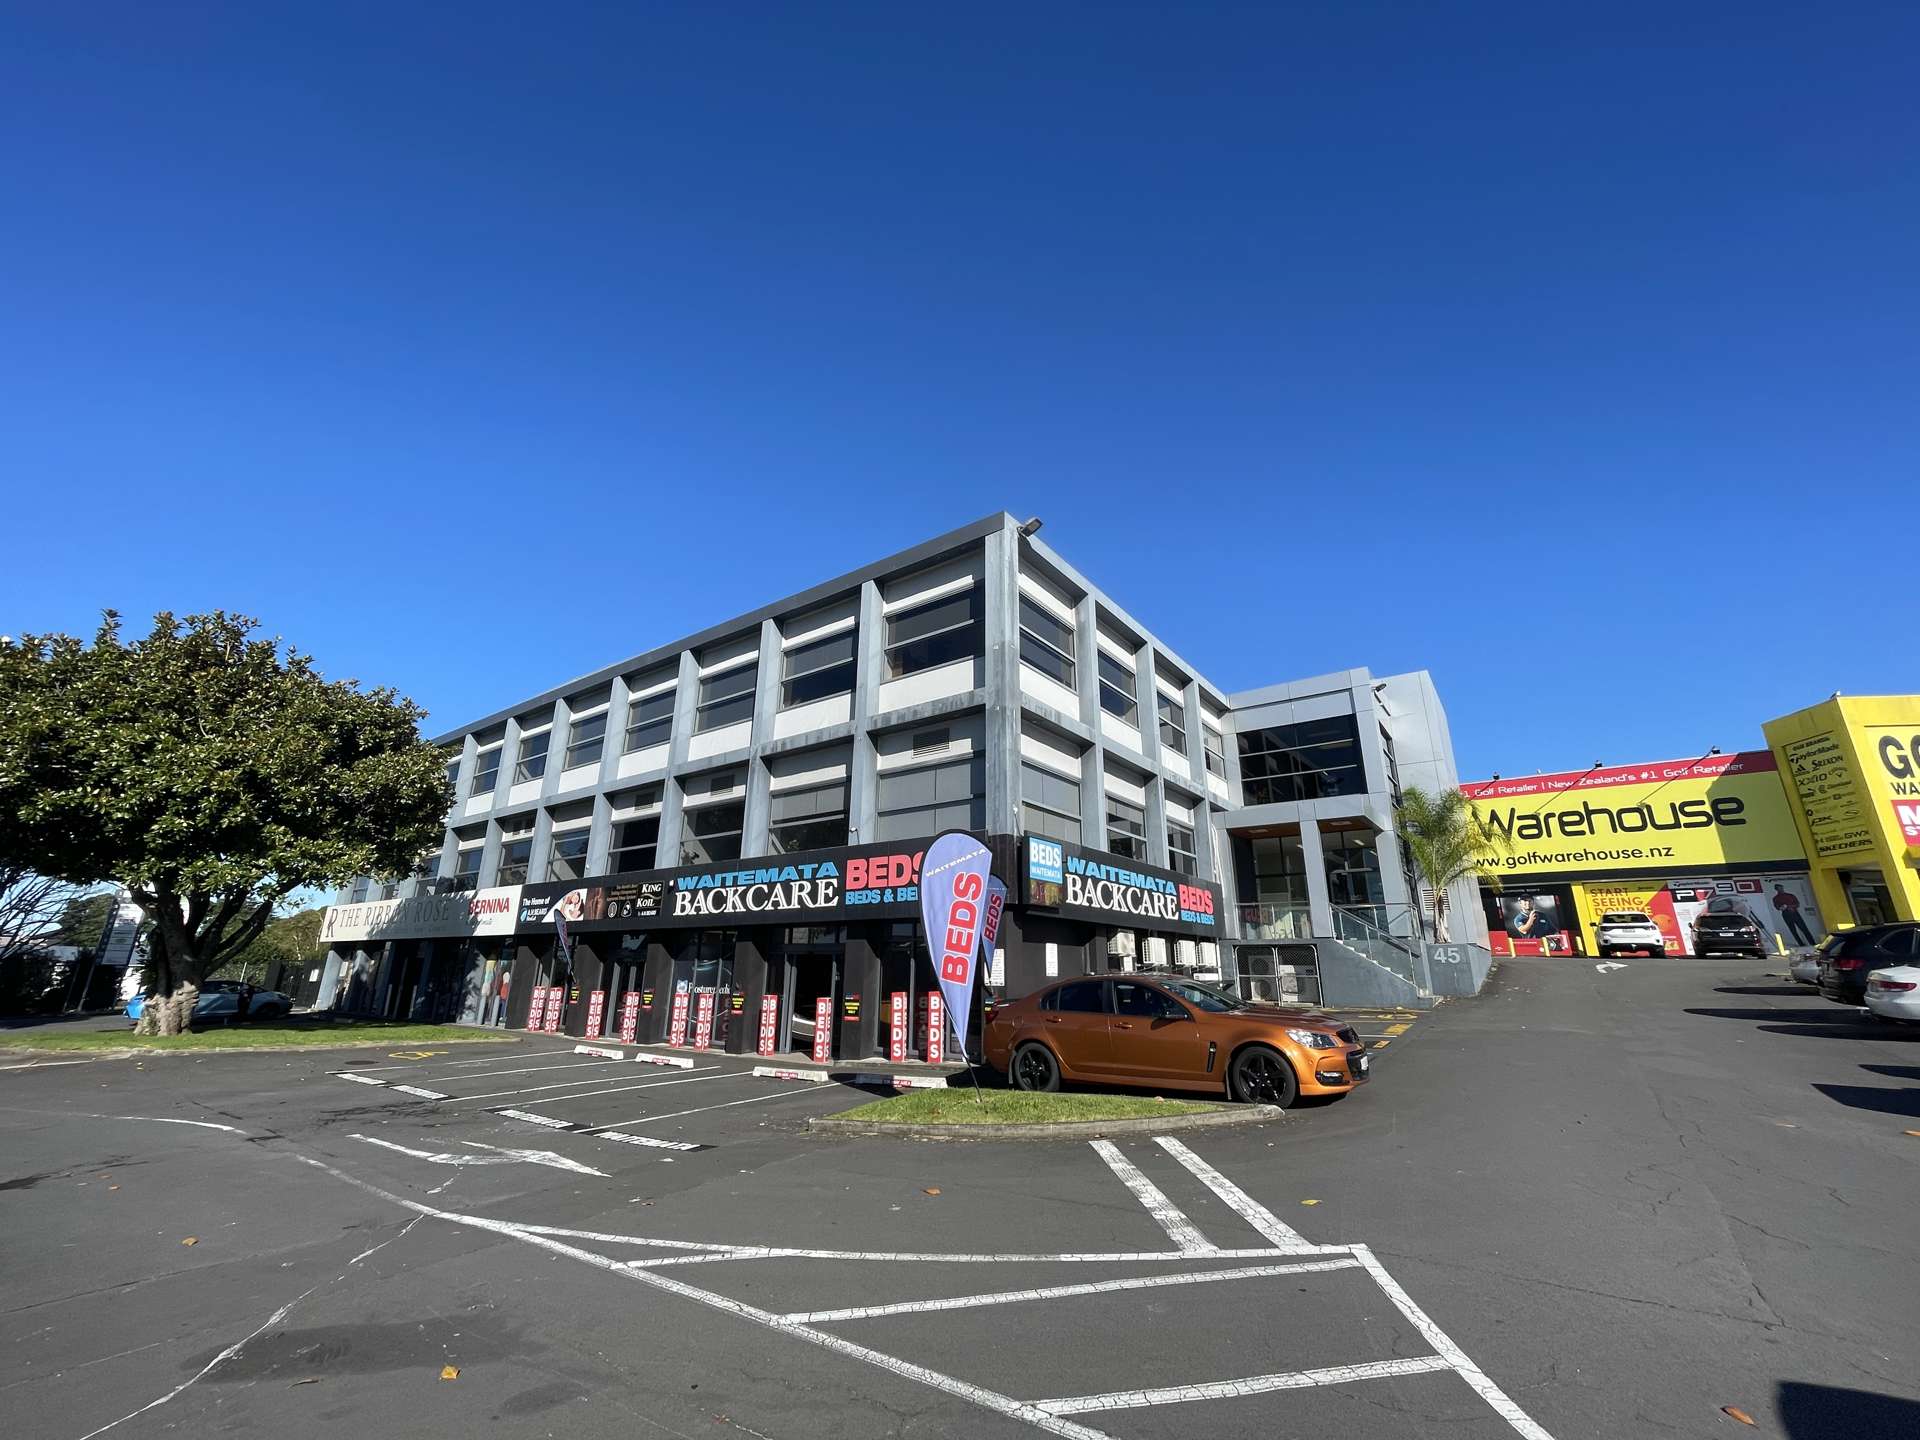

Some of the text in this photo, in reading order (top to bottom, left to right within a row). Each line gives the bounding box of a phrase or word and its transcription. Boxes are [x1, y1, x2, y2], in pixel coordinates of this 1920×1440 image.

[1498, 784, 1538, 794] Retailer
[1548, 779, 1574, 789] New
[1579, 774, 1636, 786] Zealand's
[1640, 770, 1658, 779] #1
[1663, 767, 1689, 778] Golf
[1694, 763, 1745, 774] Retailer
[1472, 797, 1746, 843] Warehouse
[925, 848, 987, 877] WAITEMATA
[1030, 842, 1061, 868] BEDS
[641, 884, 662, 893] KING
[677, 861, 839, 890] WAITEMATA
[1067, 855, 1177, 896] WAITEMATA
[1590, 887, 1629, 898] START
[339, 908, 361, 928] THE
[414, 896, 449, 923] ROSE
[468, 896, 510, 915] BERNINA
[522, 897, 531, 906] The
[545, 895, 551, 905] of
[636, 898, 655, 908] KOIL
[672, 878, 839, 916] BACKCARE
[845, 889, 881, 905] BEDS
[1065, 873, 1179, 920] BACKCARE
[1179, 884, 1214, 915] BEDS
[1593, 897, 1644, 907] SEEING
[941, 871, 984, 985] BEDS
[984, 893, 1003, 943] BEDS
[1433, 948, 1460, 964] 45
[586, 994, 597, 1036] BEDS
[593, 994, 604, 1036] BEDS
[622, 995, 633, 1041] BEDS
[671, 997, 681, 1044] BEDS
[695, 998, 706, 1047] BEDS
[767, 999, 777, 1052] BEDS
[816, 1002, 826, 1058] BEDS
[893, 997, 903, 1057] BEDS
[929, 996, 940, 1058] BEDS
